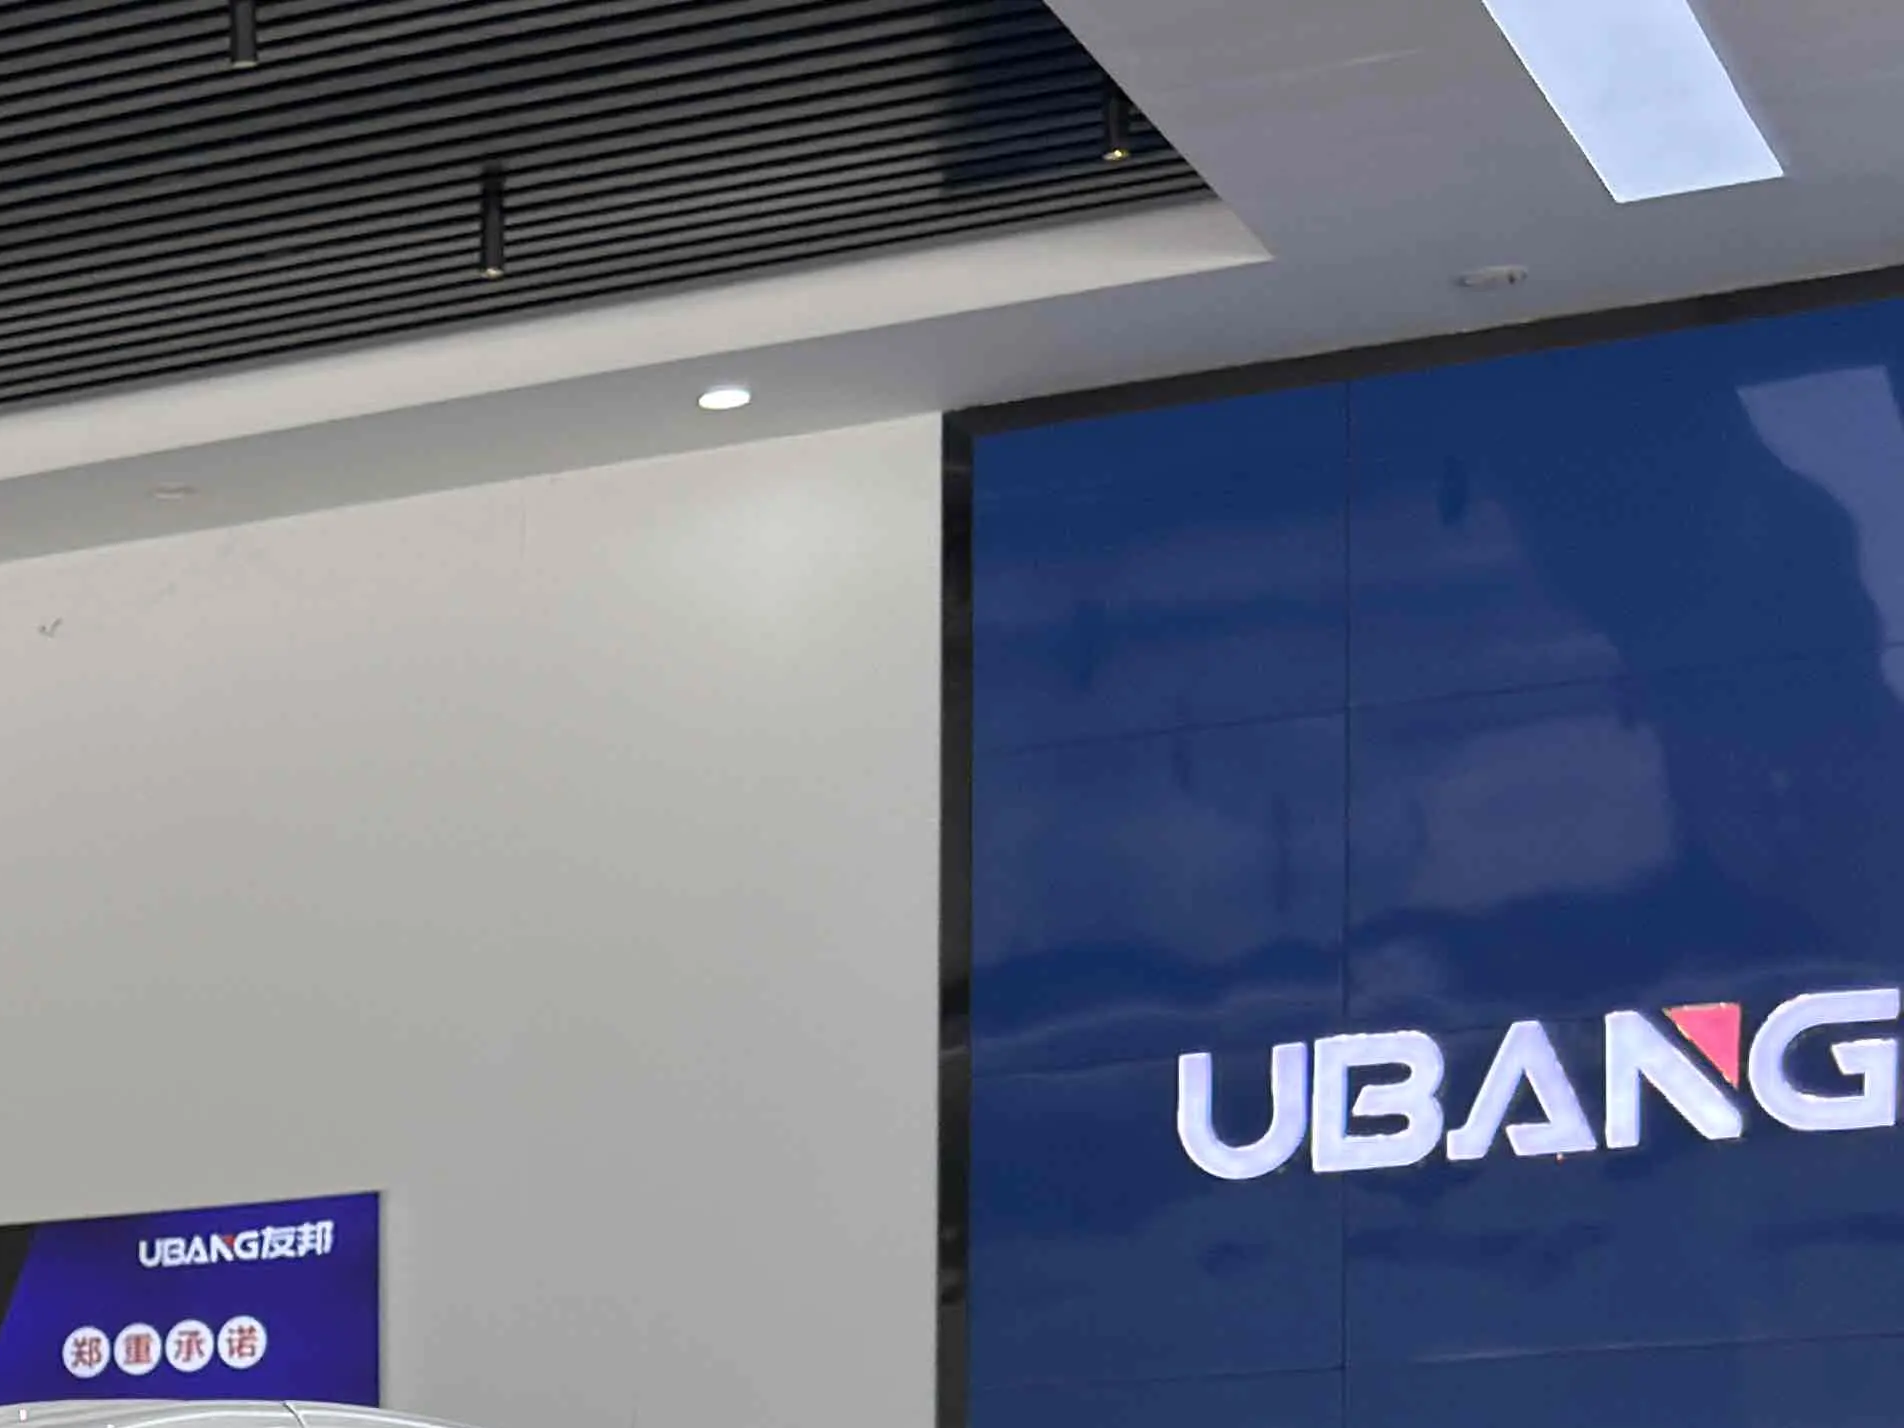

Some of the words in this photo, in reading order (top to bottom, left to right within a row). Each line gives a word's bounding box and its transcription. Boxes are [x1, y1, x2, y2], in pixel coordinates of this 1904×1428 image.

[1177, 988, 1901, 1180] UBANG
[138, 1218, 334, 1269] UBANG友邦
[69, 1324, 259, 1369] 郑重承诺
